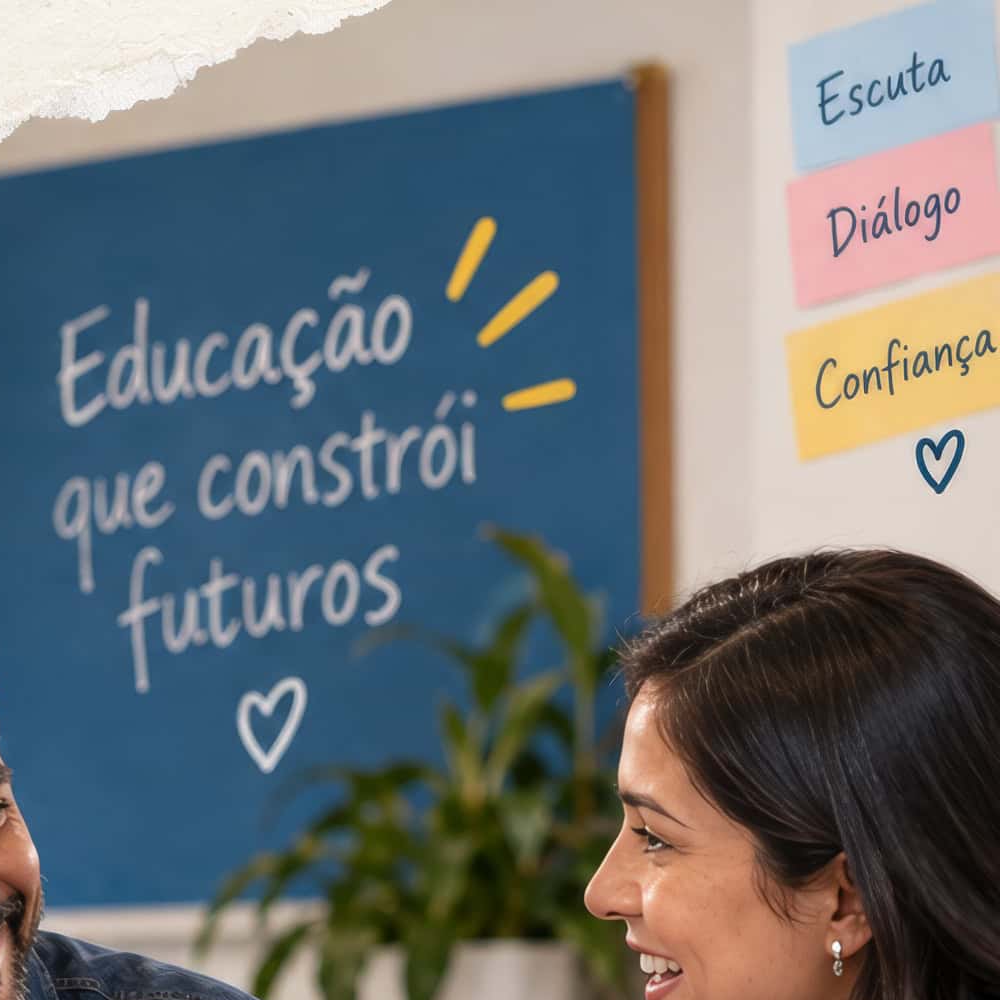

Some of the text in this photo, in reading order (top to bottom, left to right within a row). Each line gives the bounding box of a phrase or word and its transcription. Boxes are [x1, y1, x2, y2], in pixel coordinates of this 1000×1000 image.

[816, 51, 951, 126] Escuta
[826, 186, 961, 258] Diálogo
[57, 267, 413, 427] Educação
[815, 328, 999, 410] Confiança
[53, 389, 477, 593] que constrói
[116, 544, 402, 694] futuros
